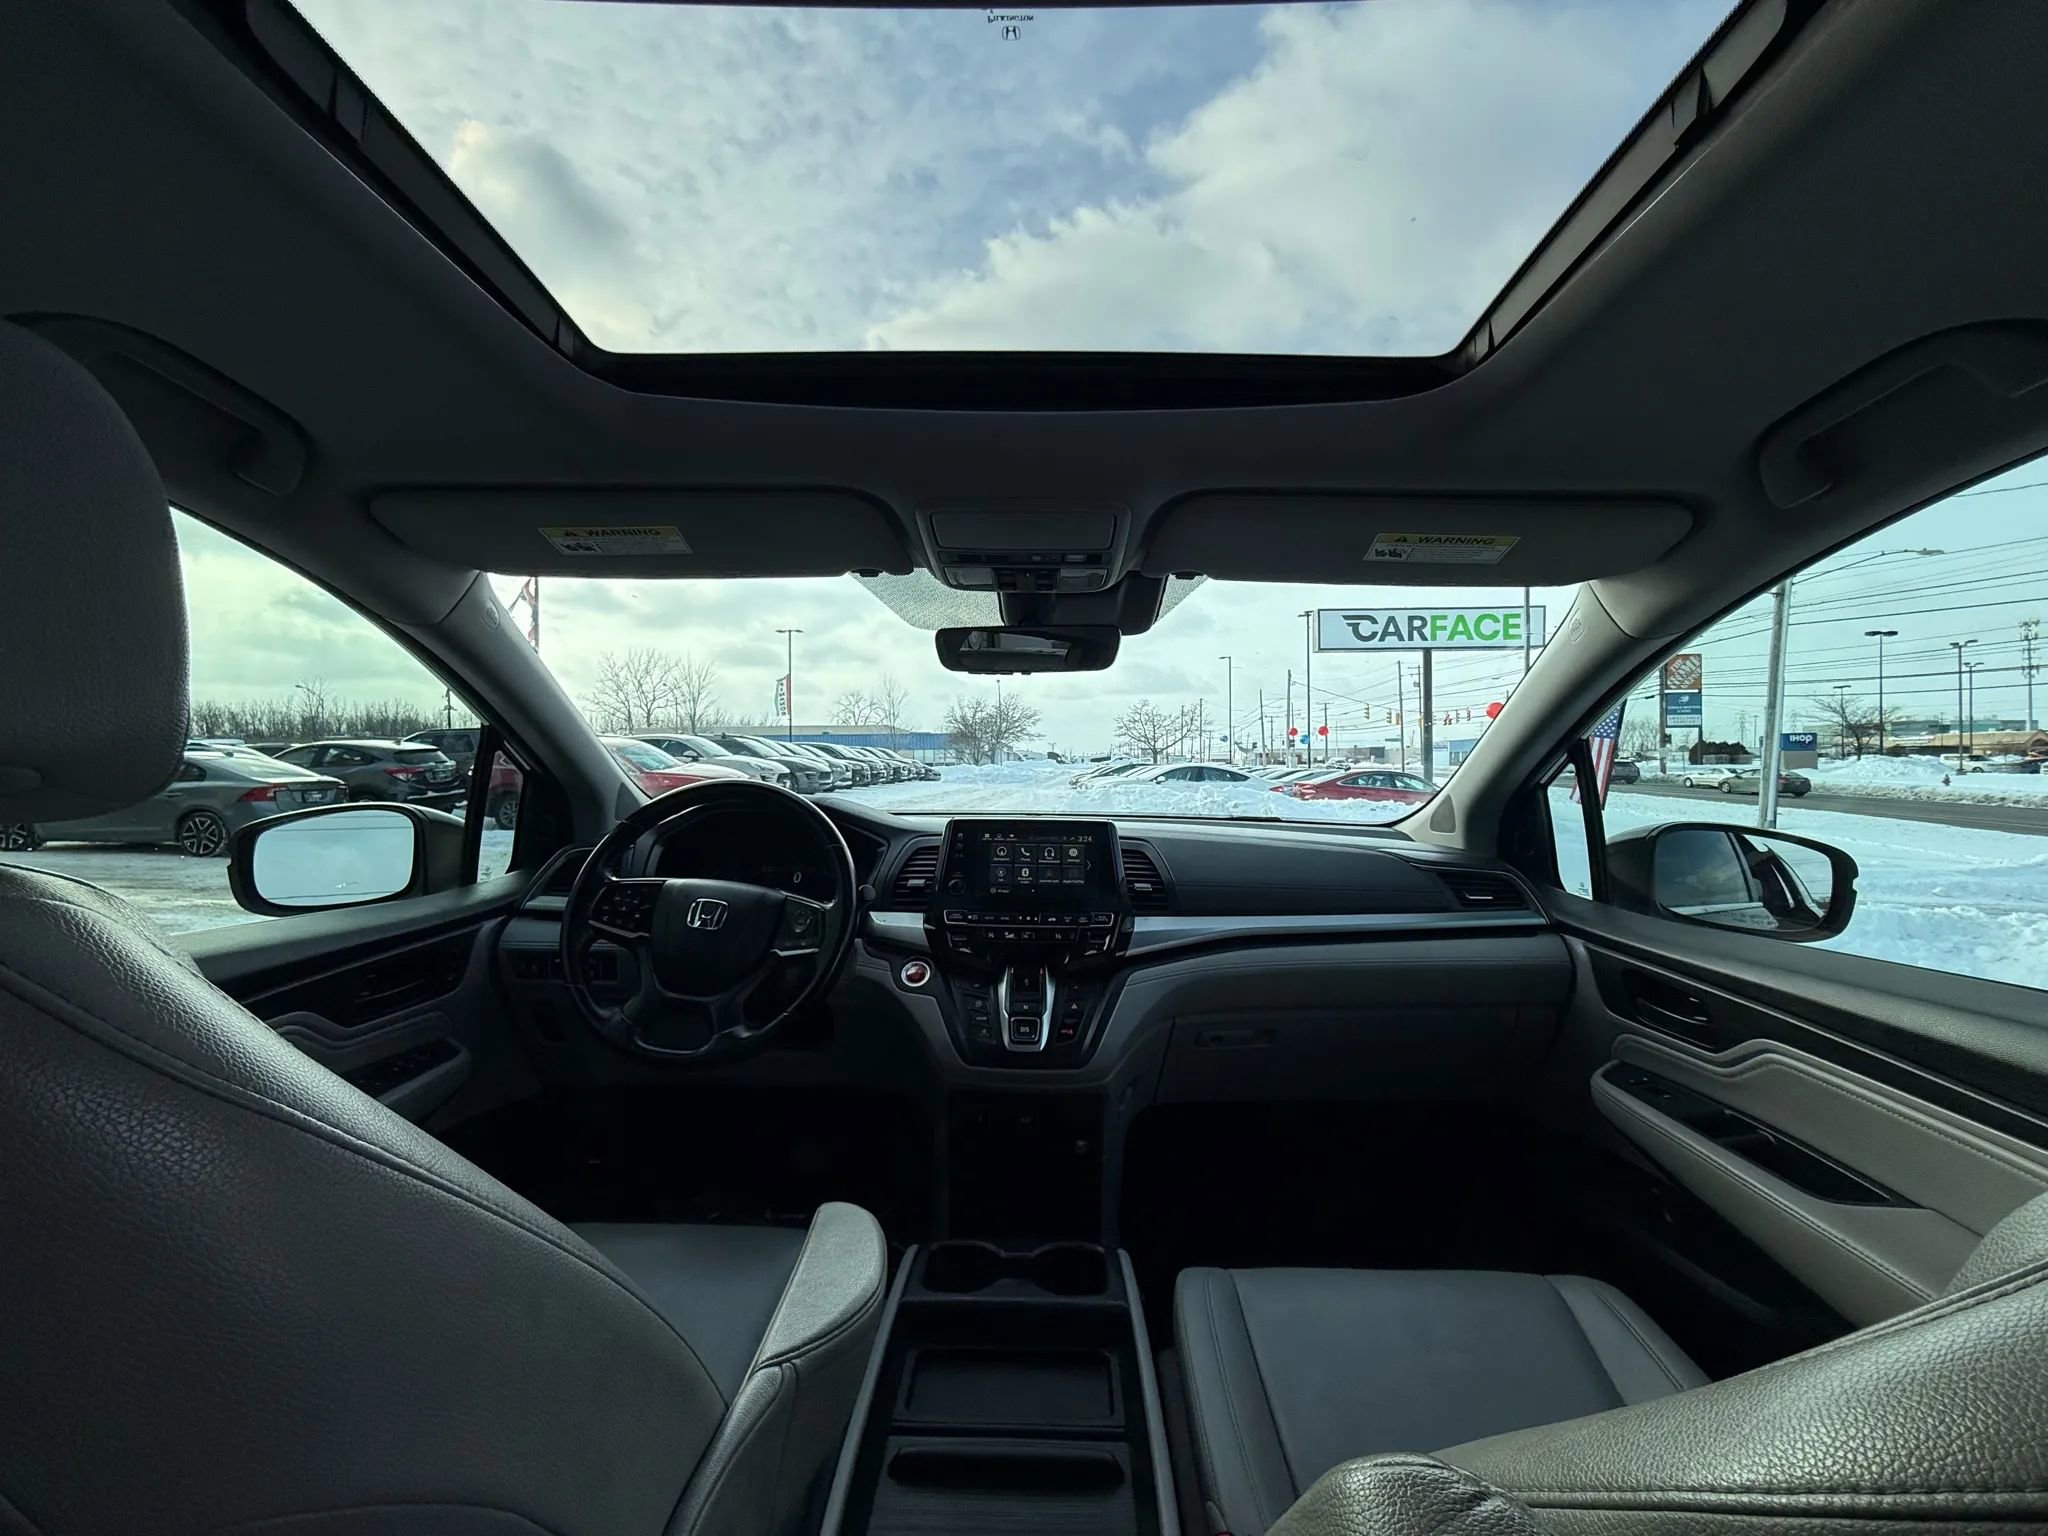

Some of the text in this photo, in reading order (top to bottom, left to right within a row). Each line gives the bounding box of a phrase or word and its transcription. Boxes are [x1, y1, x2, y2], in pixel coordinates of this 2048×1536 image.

[584, 528, 661, 537] WARNING
[1418, 536, 1496, 545] WARNING
[1341, 613, 1522, 642] CARFACE
